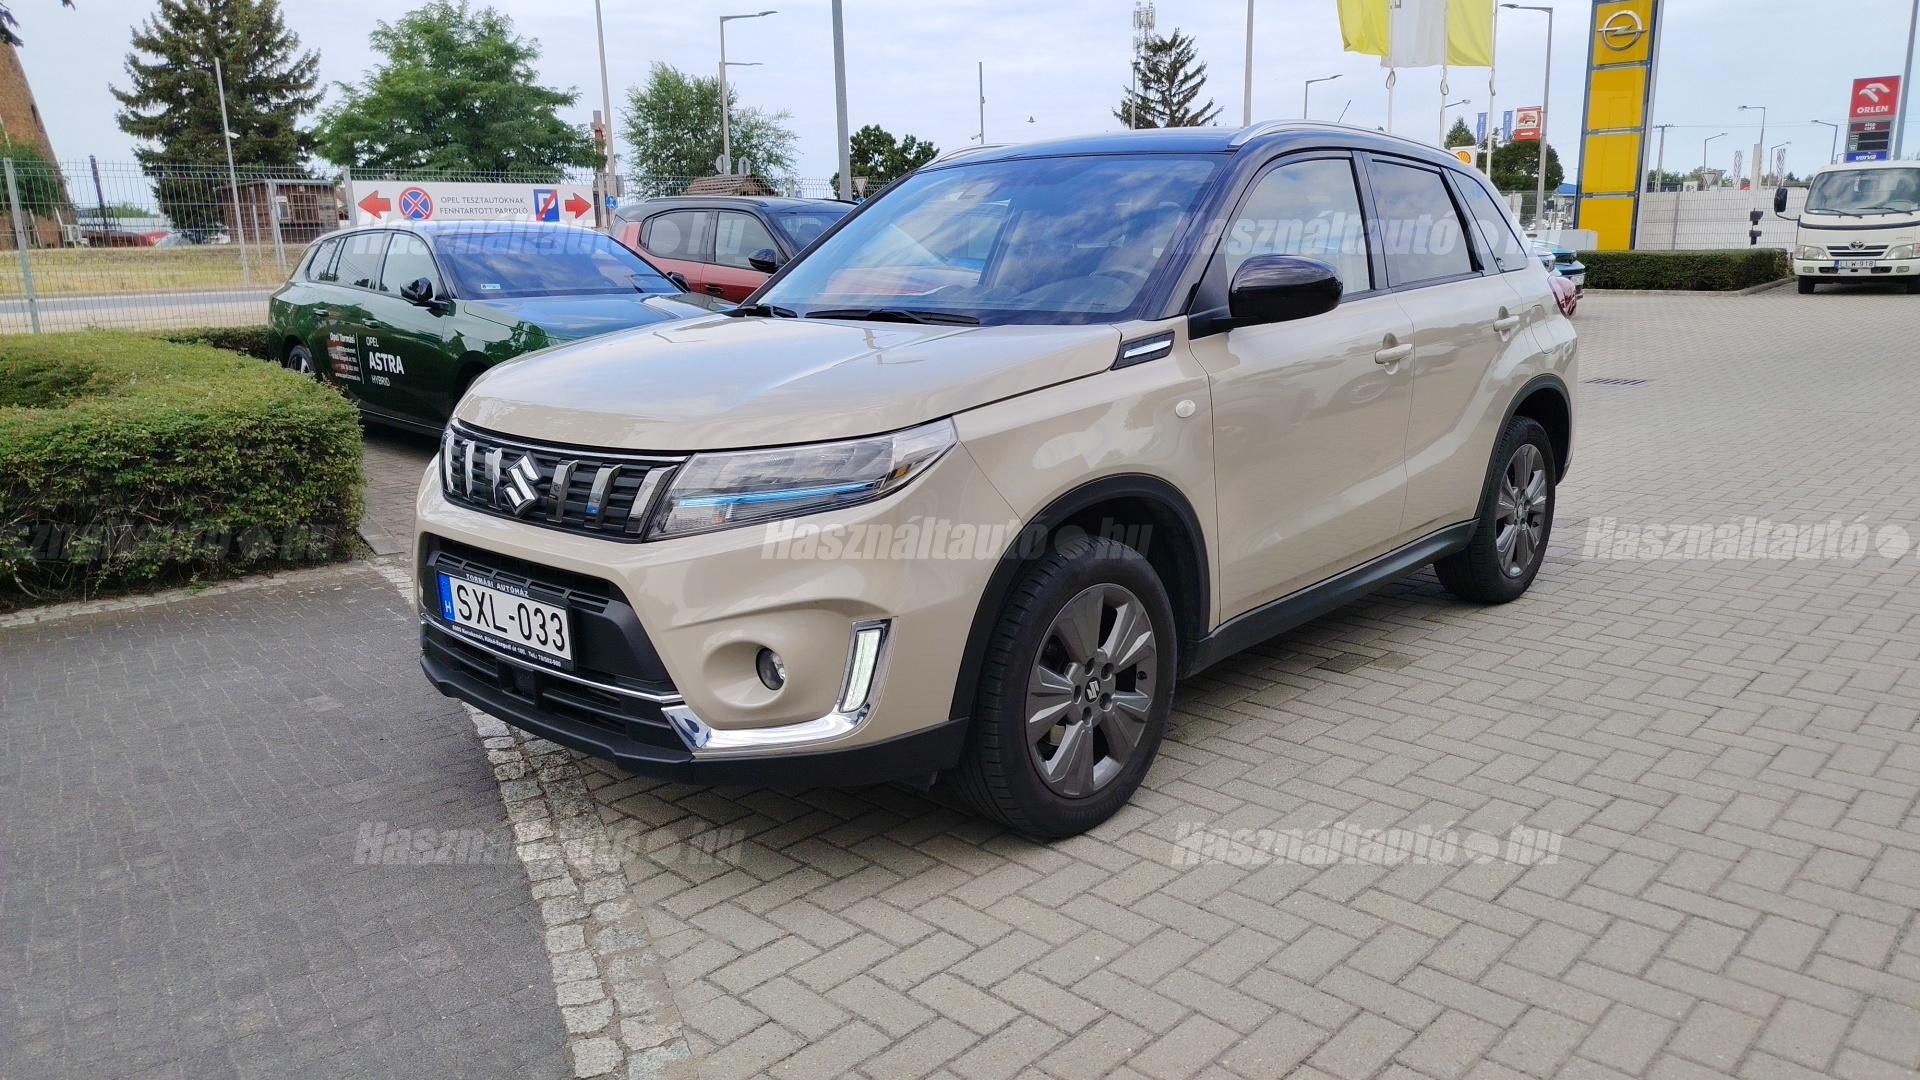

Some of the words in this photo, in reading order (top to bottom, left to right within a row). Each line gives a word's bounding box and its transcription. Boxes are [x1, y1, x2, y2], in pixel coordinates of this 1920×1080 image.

[1857, 105, 1888, 114] ORLEN
[440, 196, 460, 204] OPEL
[462, 195, 525, 204] TESZTAUTÓKNAK
[495, 206, 529, 214] PARKOLÓ
[365, 336, 379, 347] OPEL
[369, 351, 404, 374] ASTRA
[371, 374, 390, 386] HYBRID
[496, 582, 529, 597] AUTÓHÁZ
[444, 600, 451, 614] H
[456, 584, 565, 651] SXL-033
